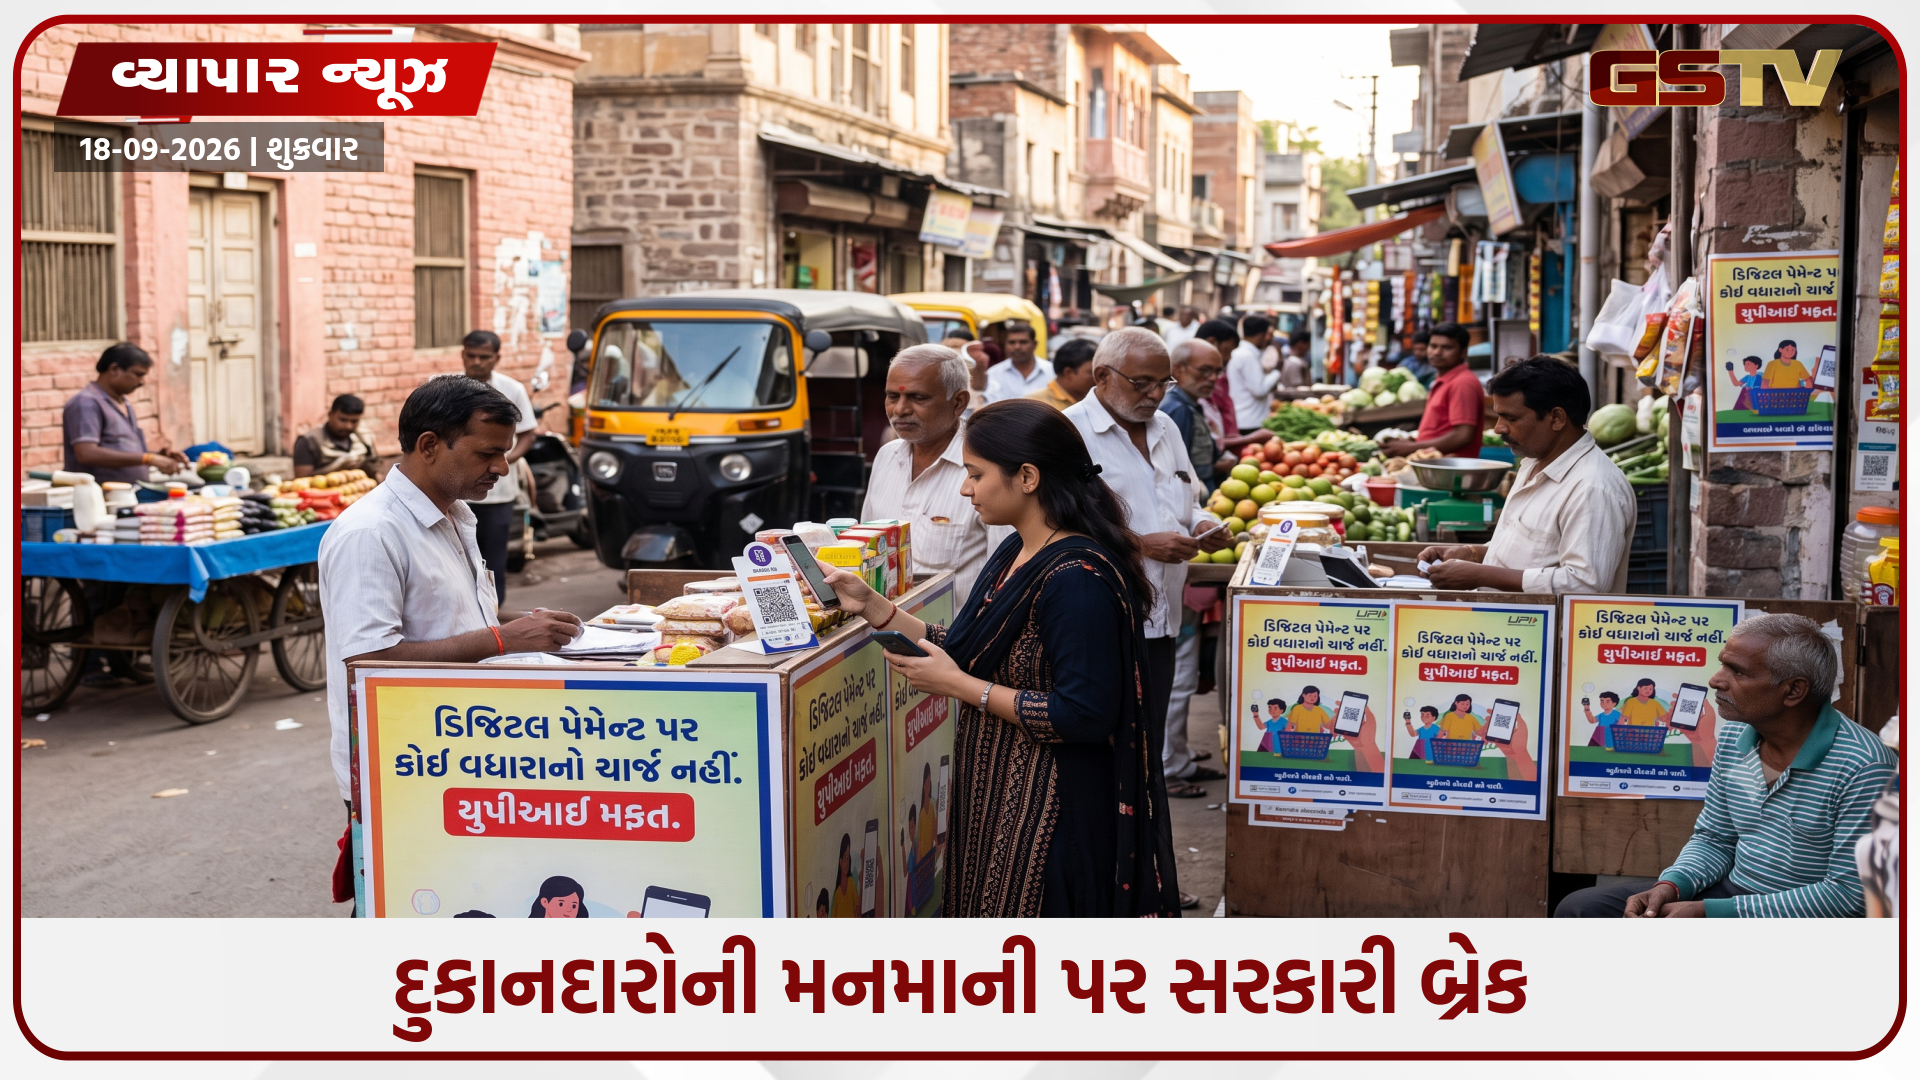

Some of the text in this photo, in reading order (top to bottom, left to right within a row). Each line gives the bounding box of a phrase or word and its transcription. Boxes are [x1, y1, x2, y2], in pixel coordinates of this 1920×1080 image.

[1733, 267, 1782, 281] ડિજિટલ
[1826, 268, 1839, 278] પ
[1720, 281, 1835, 298] કોઈ વધારાનો ચાર્જ
[1356, 610, 1382, 618] UPI
[1508, 616, 1532, 624] UPI
[1596, 609, 1709, 627] ડિજિટલ પેમેન્ટ પર
[1264, 618, 1371, 635] ડિજિટલ પેમેન્ટ પર
[1578, 625, 1603, 639] કોઈ
[1606, 627, 1660, 641] વધારાનો
[1664, 628, 1692, 643] ચાર્જ
[1247, 634, 1270, 648] કોઈ
[1273, 636, 1323, 649] વધારાનો
[1327, 637, 1355, 651] ચાર્જ
[1417, 631, 1521, 647] ડિજિટલ પેમેન્ટ પર
[1402, 645, 1424, 658] કોઈ
[1427, 647, 1476, 661] વધારાનો
[1480, 648, 1507, 662] ચાર્જ
[1603, 646, 1662, 663] યુપીઆઈ
[1271, 655, 1326, 671] યુપીઆઈ
[1423, 665, 1479, 680] યુપીઆઈ
[809, 668, 876, 732] ડિજિટલ પેમેન્ટ પર
[435, 705, 699, 742] ડિજિટલ પેમેન્ટ પર
[799, 742, 816, 781] કોઈ
[818, 715, 850, 765] વધારાનો
[853, 702, 868, 739] ચાર્જ
[395, 744, 742, 785] કોઈ વધારાનો ચાર્જ નહીં.
[817, 759, 853, 819] યુપીઆઈ
[458, 791, 680, 834] યુપીઆઈ મફત.
